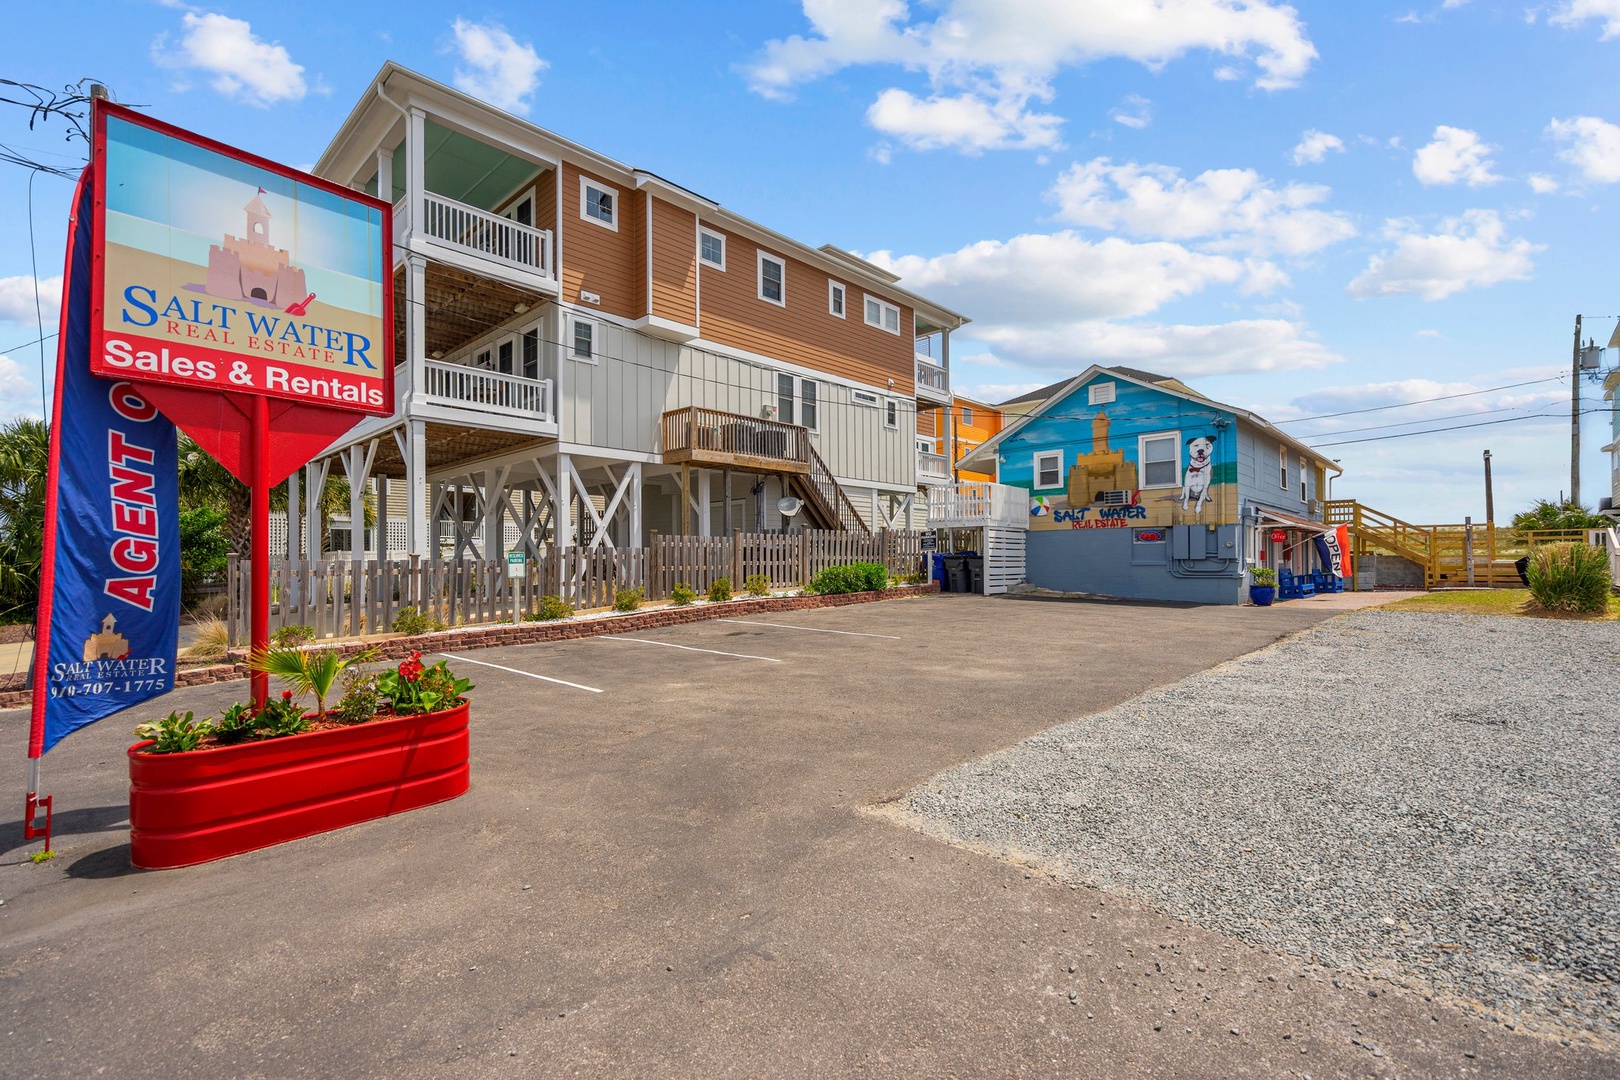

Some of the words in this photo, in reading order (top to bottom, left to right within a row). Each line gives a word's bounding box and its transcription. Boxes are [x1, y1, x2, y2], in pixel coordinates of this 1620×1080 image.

[122, 285, 236, 330] SALT
[245, 311, 377, 370] WATER
[166, 320, 235, 345] REAL
[248, 336, 335, 364] ESTATE
[104, 339, 217, 380] Sales
[228, 360, 254, 387] &
[266, 366, 384, 406] Rentals
[104, 428, 160, 613] AGENT
[1053, 507, 1091, 523] SALT
[1099, 505, 1147, 519] WATER
[1072, 519, 1094, 530] REAL
[1095, 518, 1128, 529] ESTATE
[1324, 535, 1341, 571] OPEN
[51, 661, 93, 682] SALT
[97, 657, 168, 675] WATER
[66, 673, 92, 682] REAL
[97, 669, 145, 679] ESTATE
[51, 678, 165, 700] 910-707-1775
